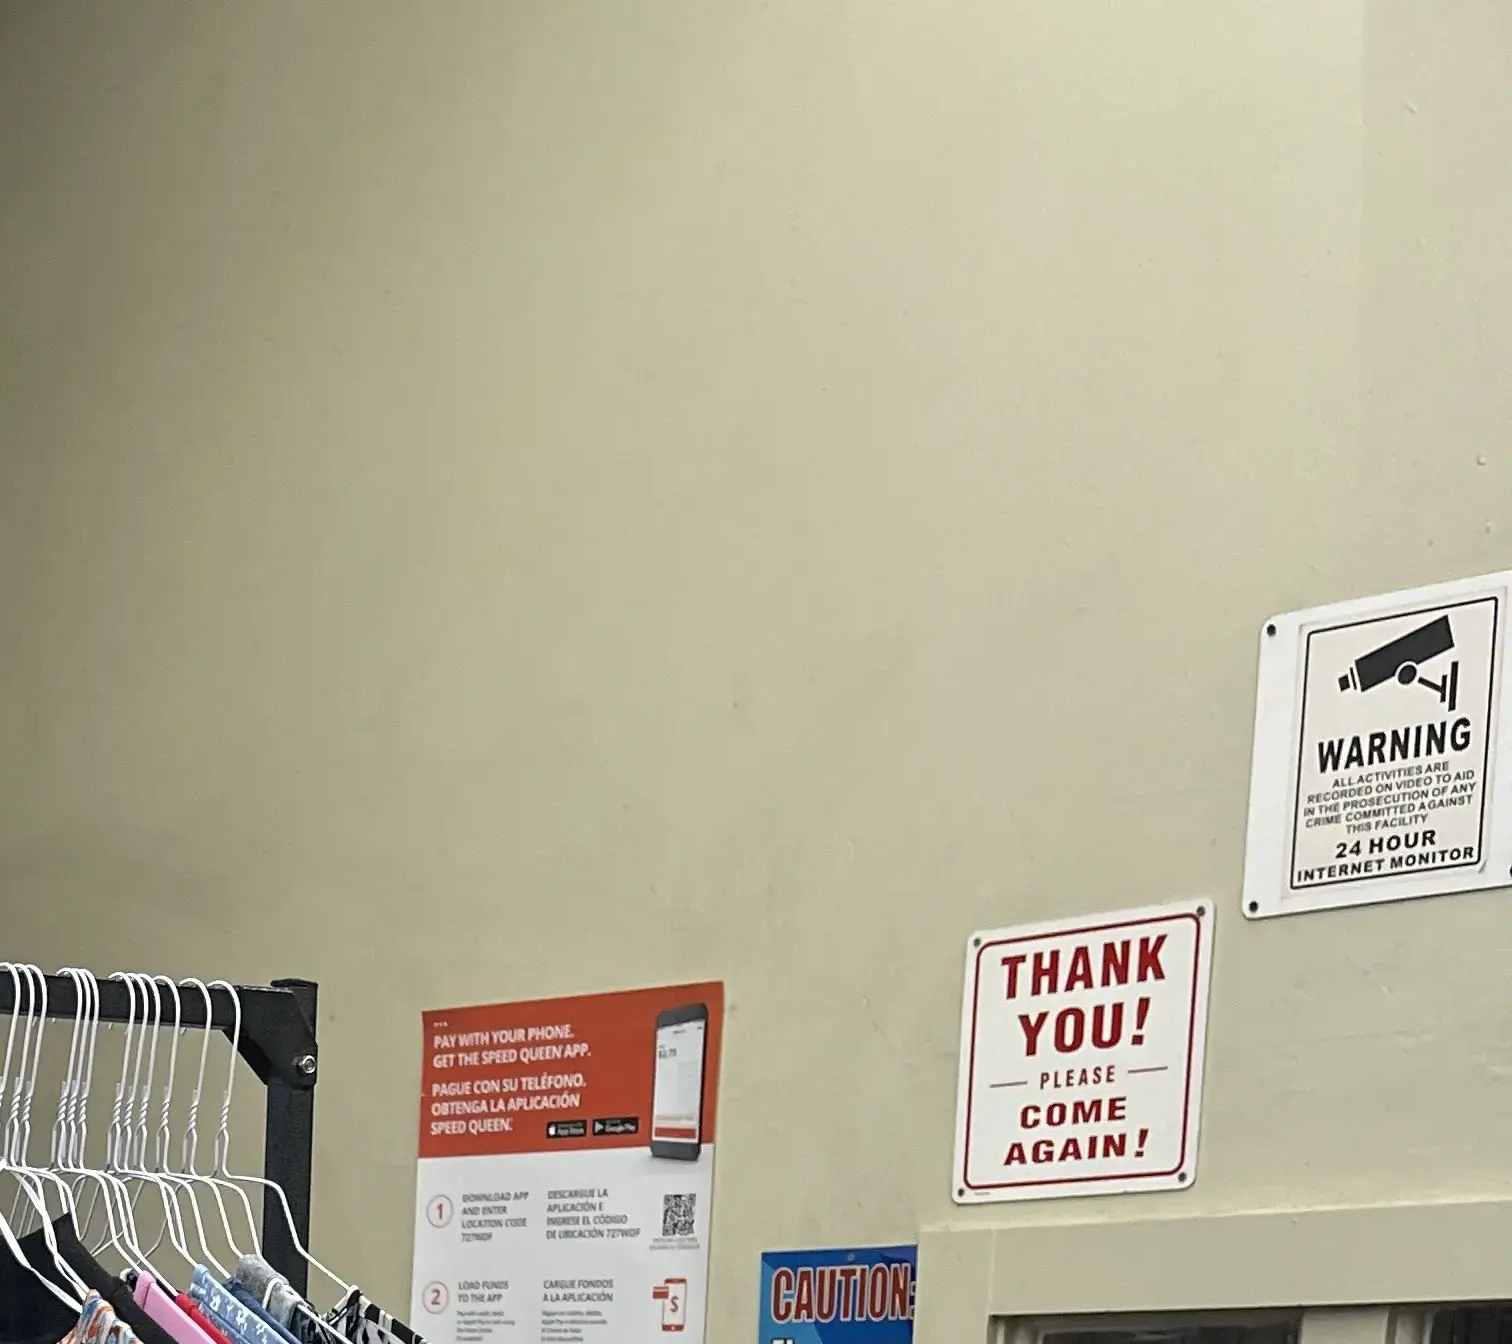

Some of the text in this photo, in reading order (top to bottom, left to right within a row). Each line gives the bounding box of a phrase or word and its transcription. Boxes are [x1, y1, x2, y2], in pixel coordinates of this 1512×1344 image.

[1317, 717, 1471, 773] WARNING
[1307, 769, 1475, 805] RECORDED ON VIDEO TO AID
[1332, 761, 1449, 789] ALL ACTIVITIES ARE
[1304, 782, 1477, 818] IN THE PROSECUTION OF ANY
[1305, 794, 1473, 828] CRIME COMMITTED AGAINST
[1345, 814, 1429, 835] THIS FACILITY
[1335, 829, 1436, 859] 24 HOUR
[1297, 847, 1475, 883] INTERNET MONITOR
[1001, 934, 1168, 1000] THANK
[433, 1033, 460, 1049] PAY
[459, 1031, 489, 1048] WITH
[491, 1028, 526, 1044] YOUR
[1017, 997, 1151, 1057] YOU!
[433, 1043, 592, 1068] GET THE SPEED QUEEN APP.
[432, 1079, 473, 1097] PAGUE
[473, 1079, 500, 1095] CON
[502, 1078, 518, 1092] SU
[1040, 1065, 1117, 1090] PLEASE
[431, 1091, 581, 1116] OBTENGA LA APLICACIÓN
[1020, 1096, 1128, 1129] COME
[431, 1119, 467, 1135] SPEED
[1003, 1129, 1150, 1166] AGAIN!
[430, 1288, 441, 1305] 2
